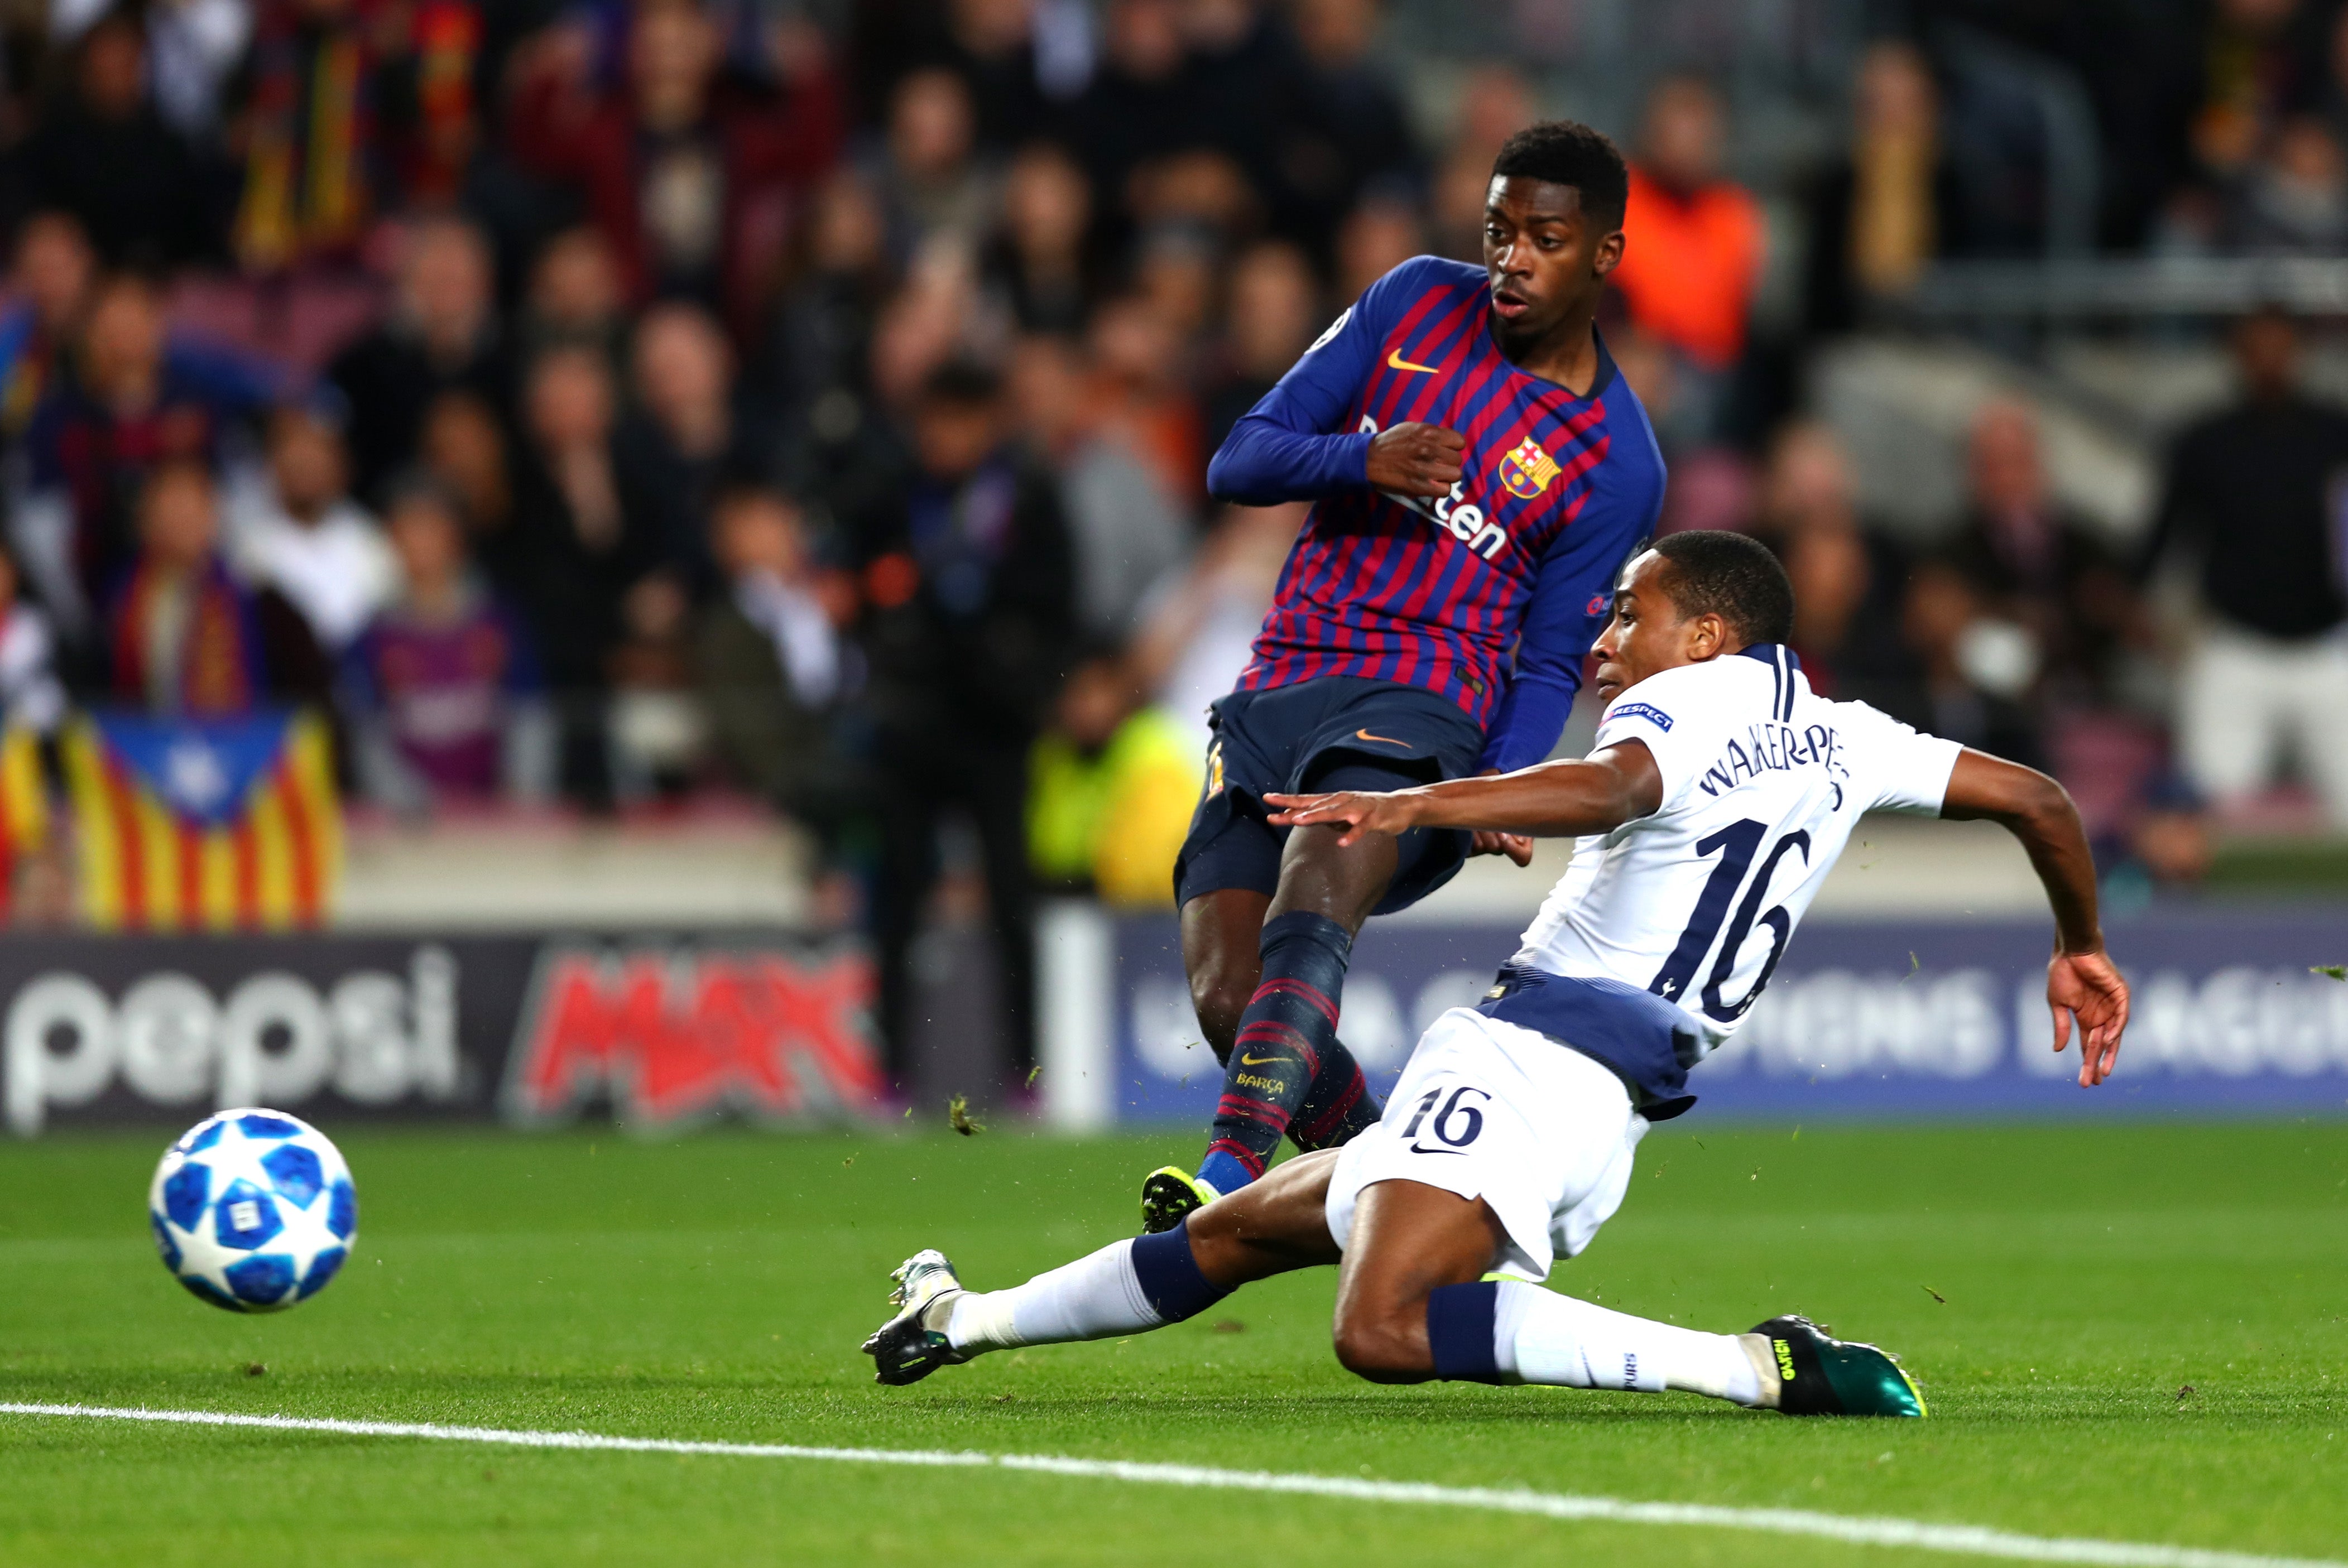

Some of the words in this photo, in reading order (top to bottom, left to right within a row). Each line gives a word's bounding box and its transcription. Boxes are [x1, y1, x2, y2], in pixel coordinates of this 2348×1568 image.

[1612, 704, 1673, 728] RESPECT
[1648, 817, 1811, 1023] 16
[7, 944, 458, 1136] pepsi
[1236, 1072, 1284, 1094] BARÇA
[1400, 1086, 1492, 1147] 16
